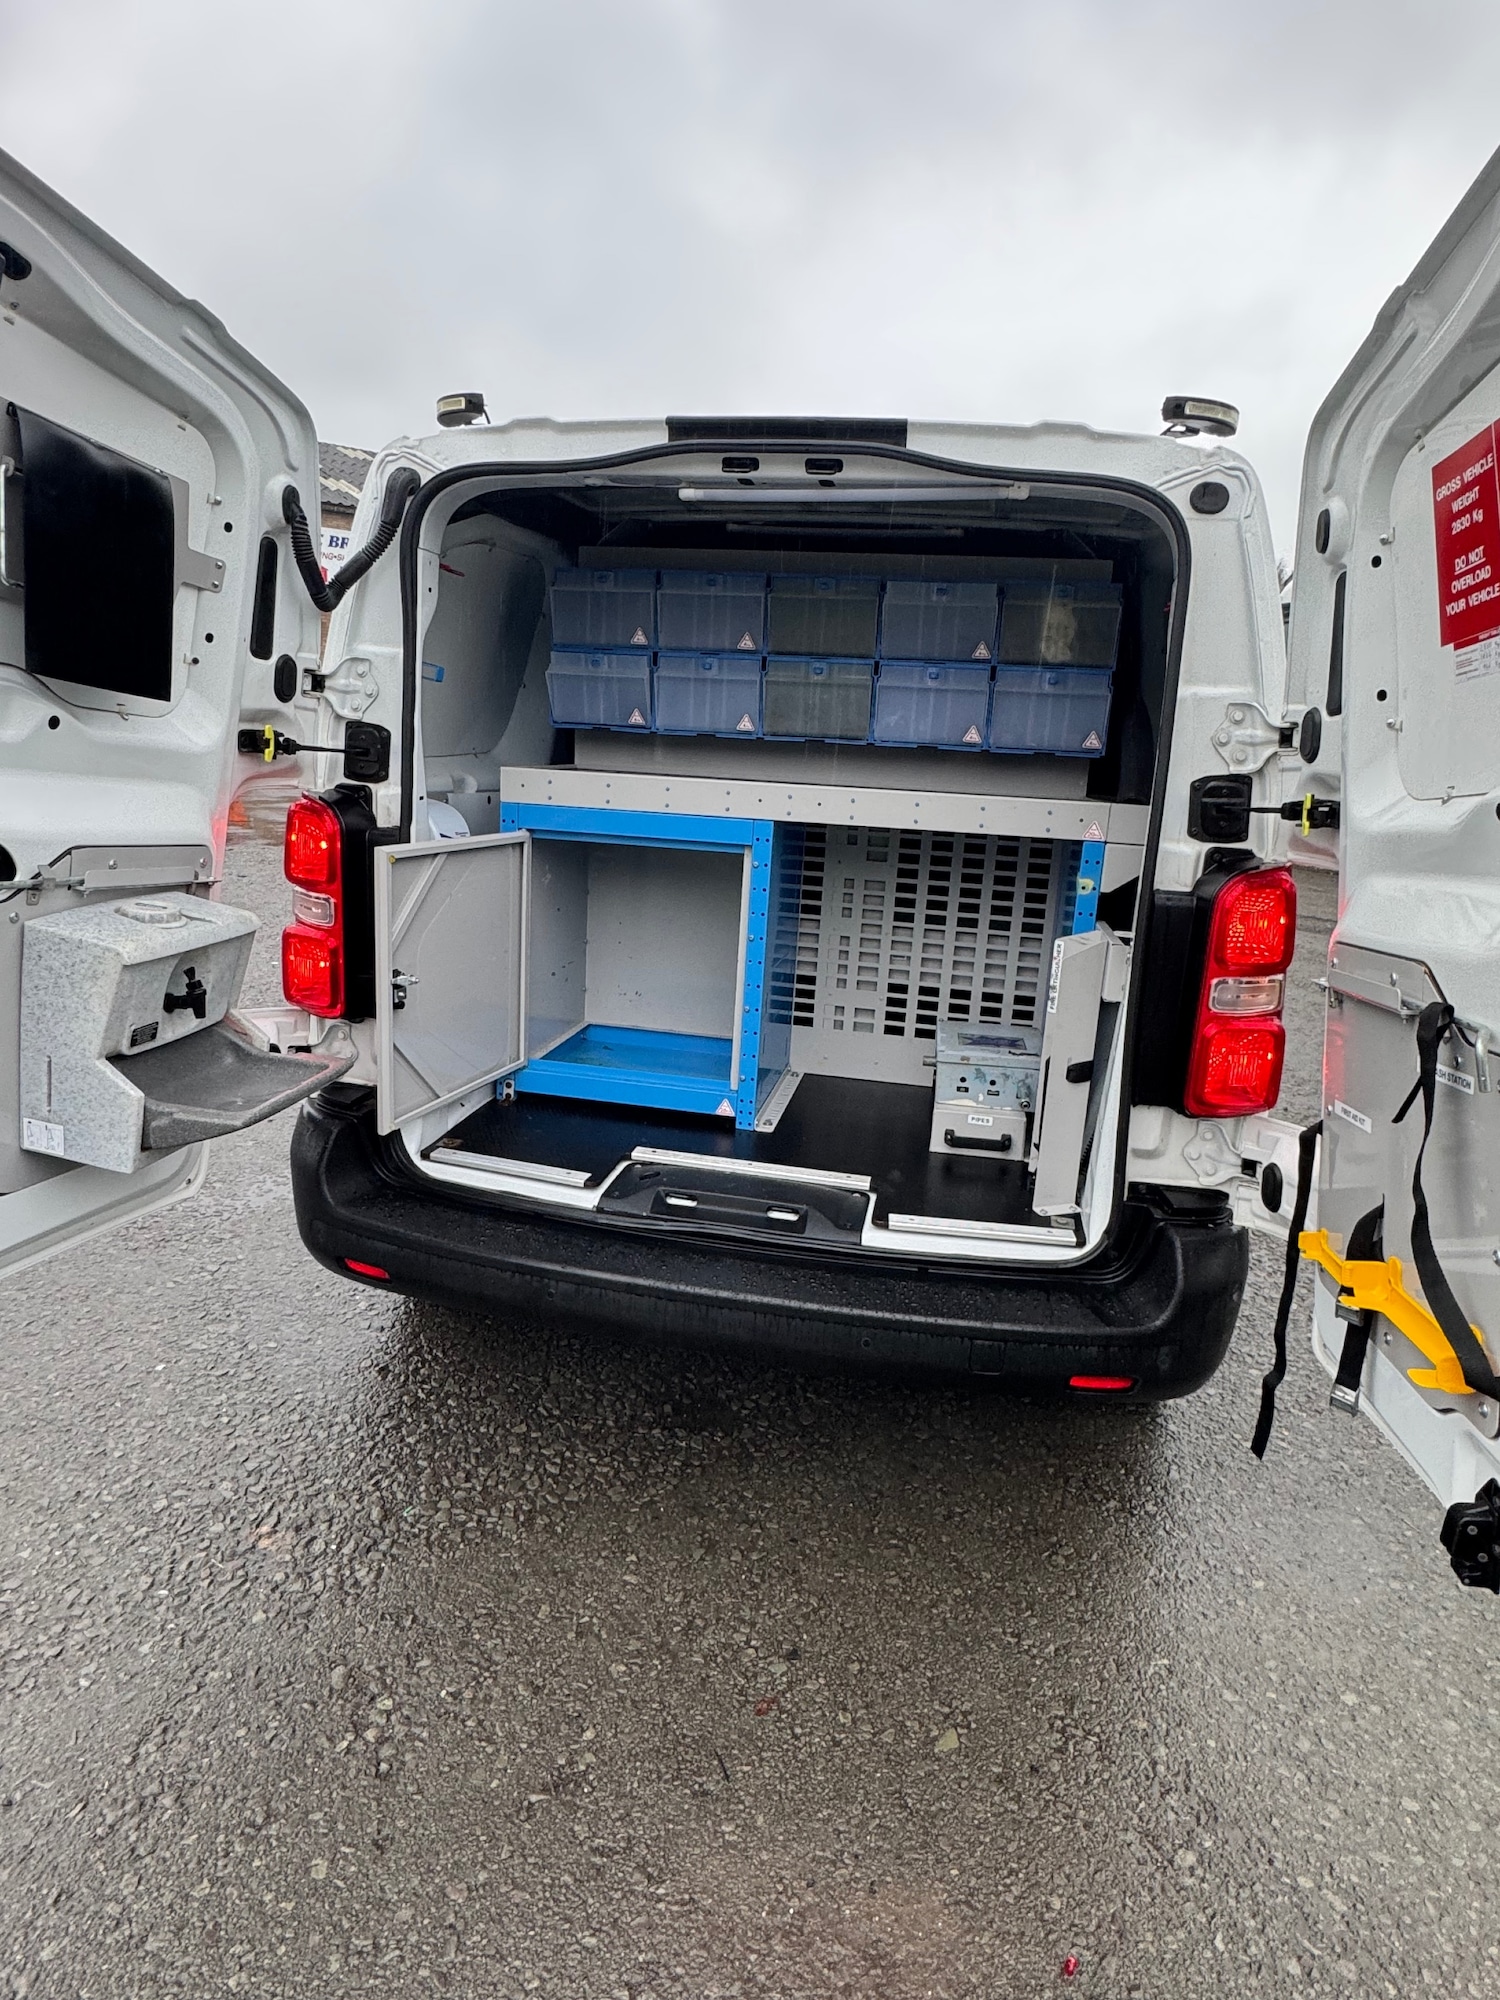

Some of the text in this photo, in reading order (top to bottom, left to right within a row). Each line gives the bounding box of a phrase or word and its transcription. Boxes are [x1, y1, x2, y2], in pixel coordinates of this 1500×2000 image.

[1436, 453, 1493, 501] GROSS VEHICLE
[1451, 486, 1479, 513] WEIGHT
[1452, 509, 1483, 535] 2830 Kg
[1455, 545, 1484, 571] DO NOT
[1451, 565, 1491, 594] OVERLOAD
[1446, 582, 1500, 616] YOUR VEHICLE
[1447, 1073, 1471, 1089] STATION
